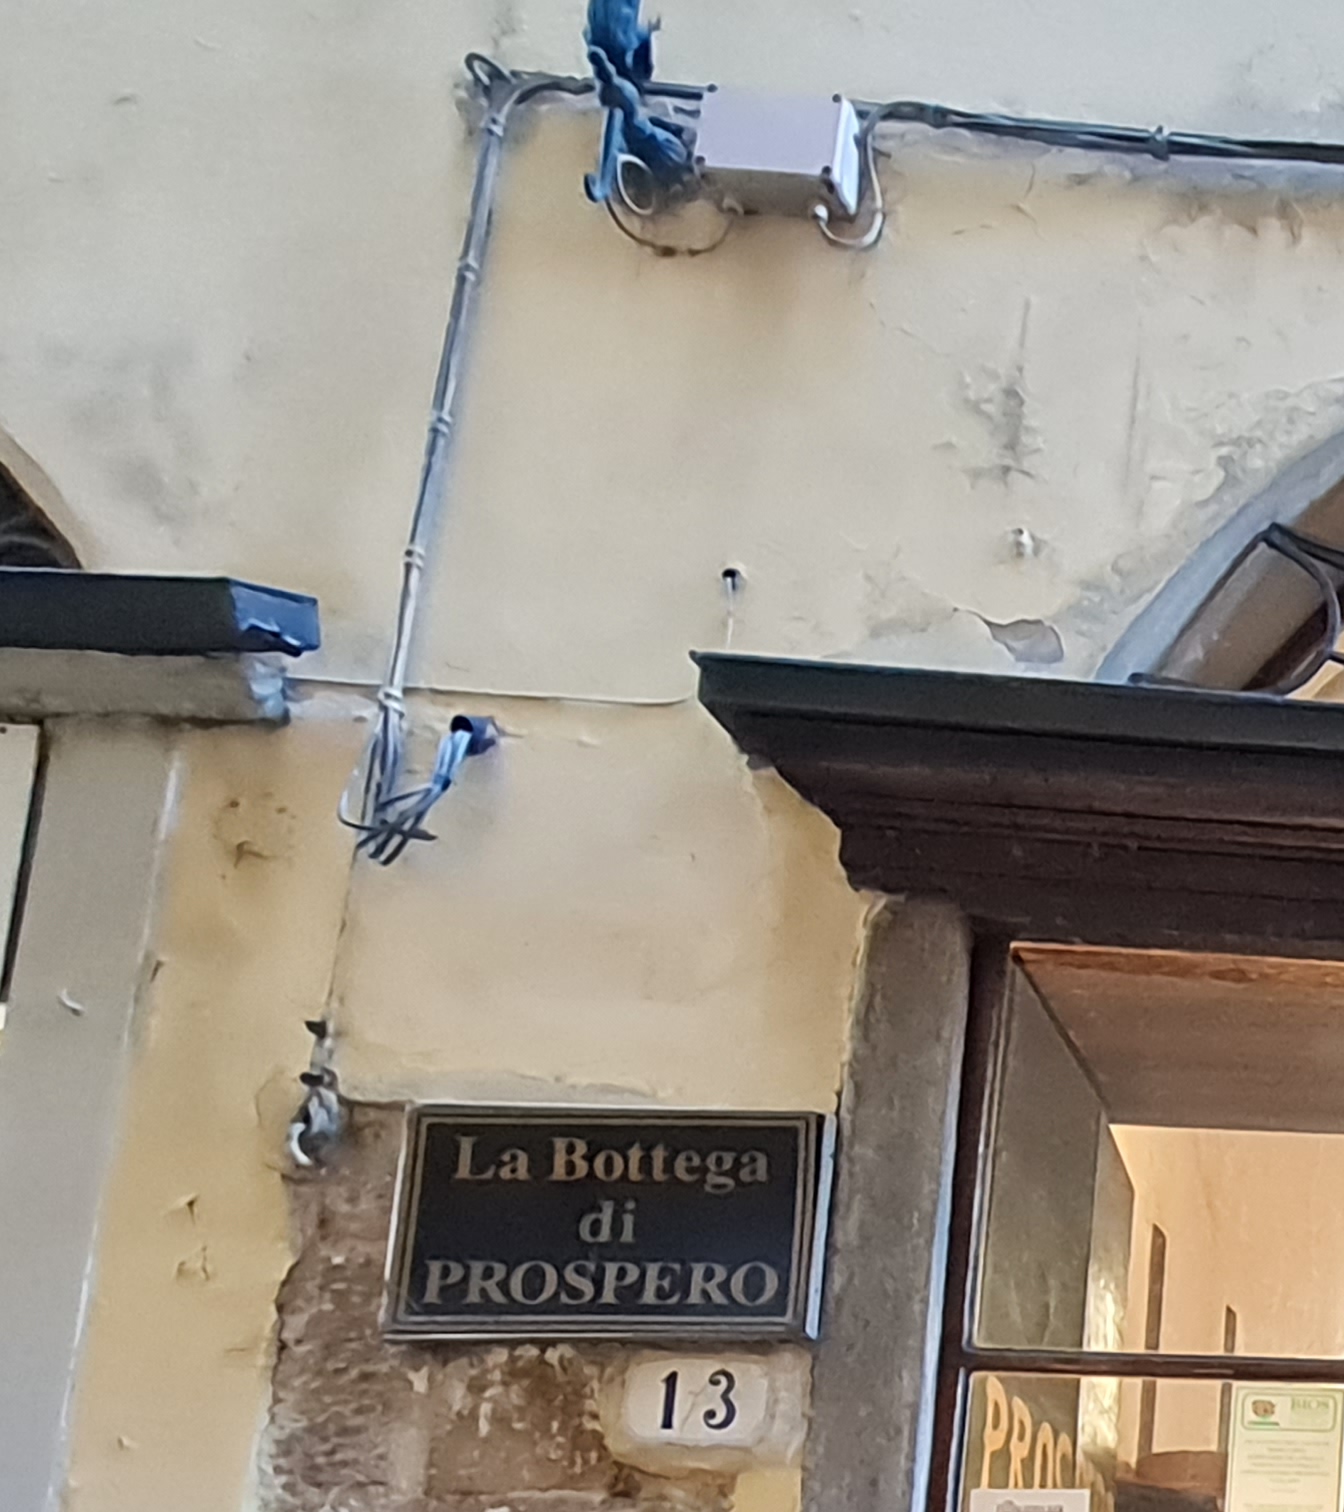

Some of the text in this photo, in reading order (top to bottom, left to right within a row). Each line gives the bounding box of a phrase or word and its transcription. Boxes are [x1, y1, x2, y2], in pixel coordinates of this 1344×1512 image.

[453, 1136, 769, 1195] La Bottega
[578, 1199, 636, 1244] di
[421, 1259, 780, 1307] PROSPERO
[659, 1368, 738, 1431] 13
